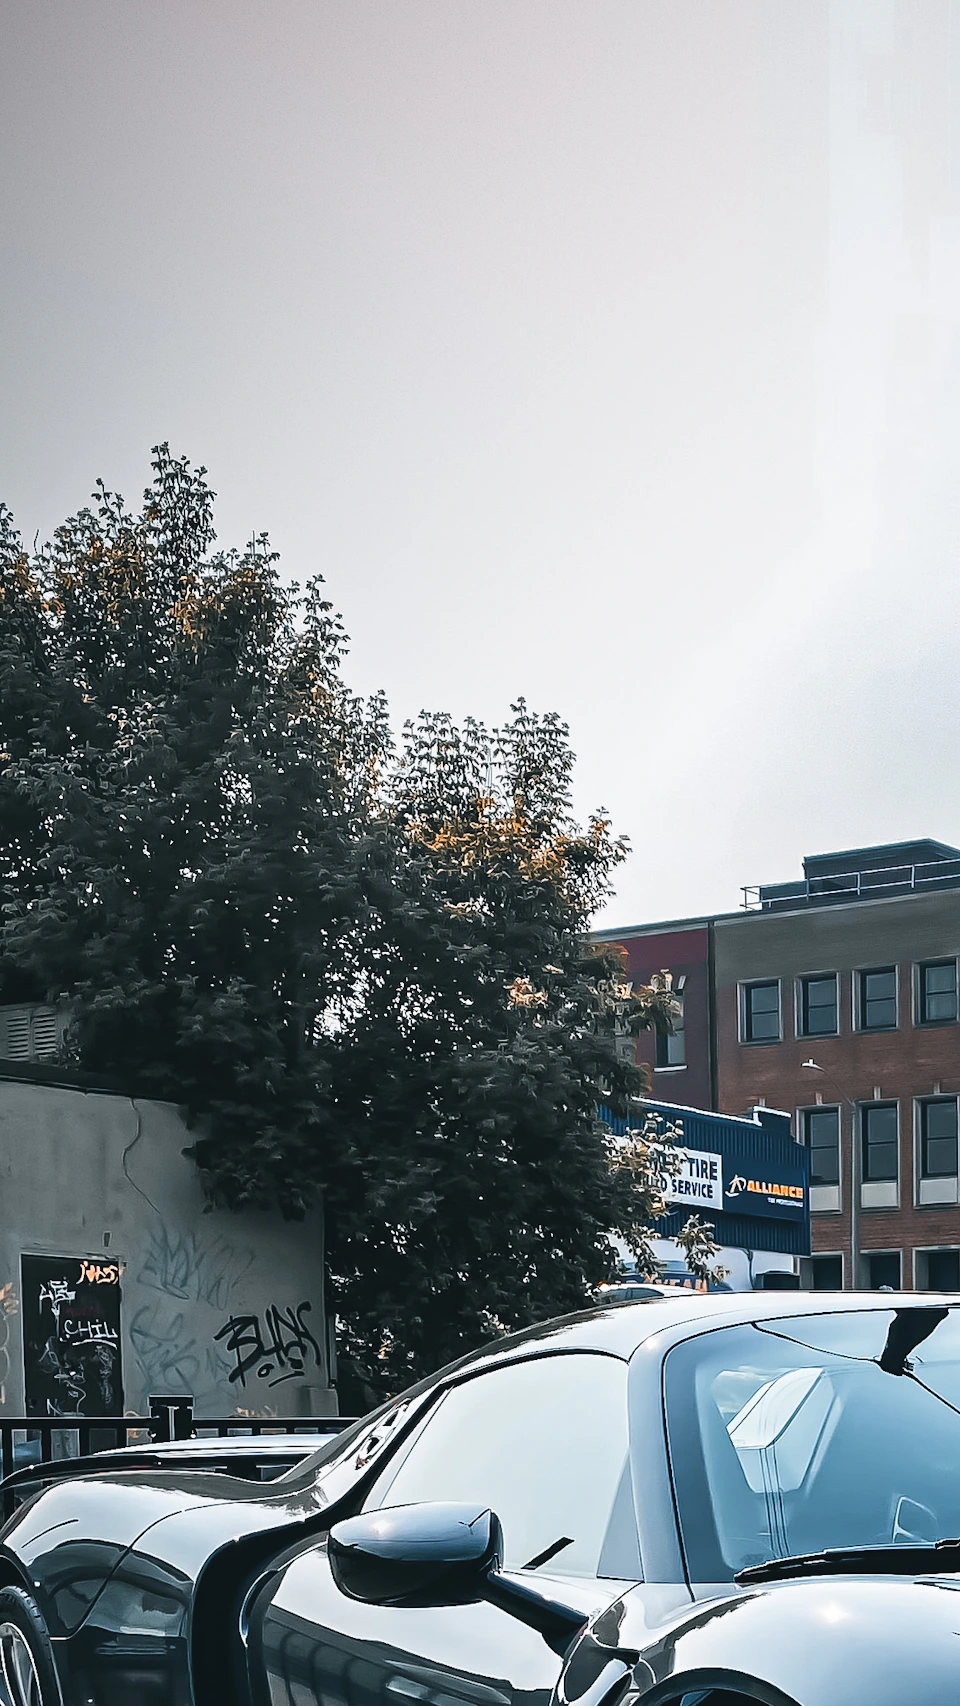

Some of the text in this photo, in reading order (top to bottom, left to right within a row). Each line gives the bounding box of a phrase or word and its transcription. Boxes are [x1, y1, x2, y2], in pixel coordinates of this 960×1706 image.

[687, 1158, 718, 1180] TIRE
[671, 1179, 713, 1198] SERVICE
[746, 1179, 803, 1199] ALLIANCE
